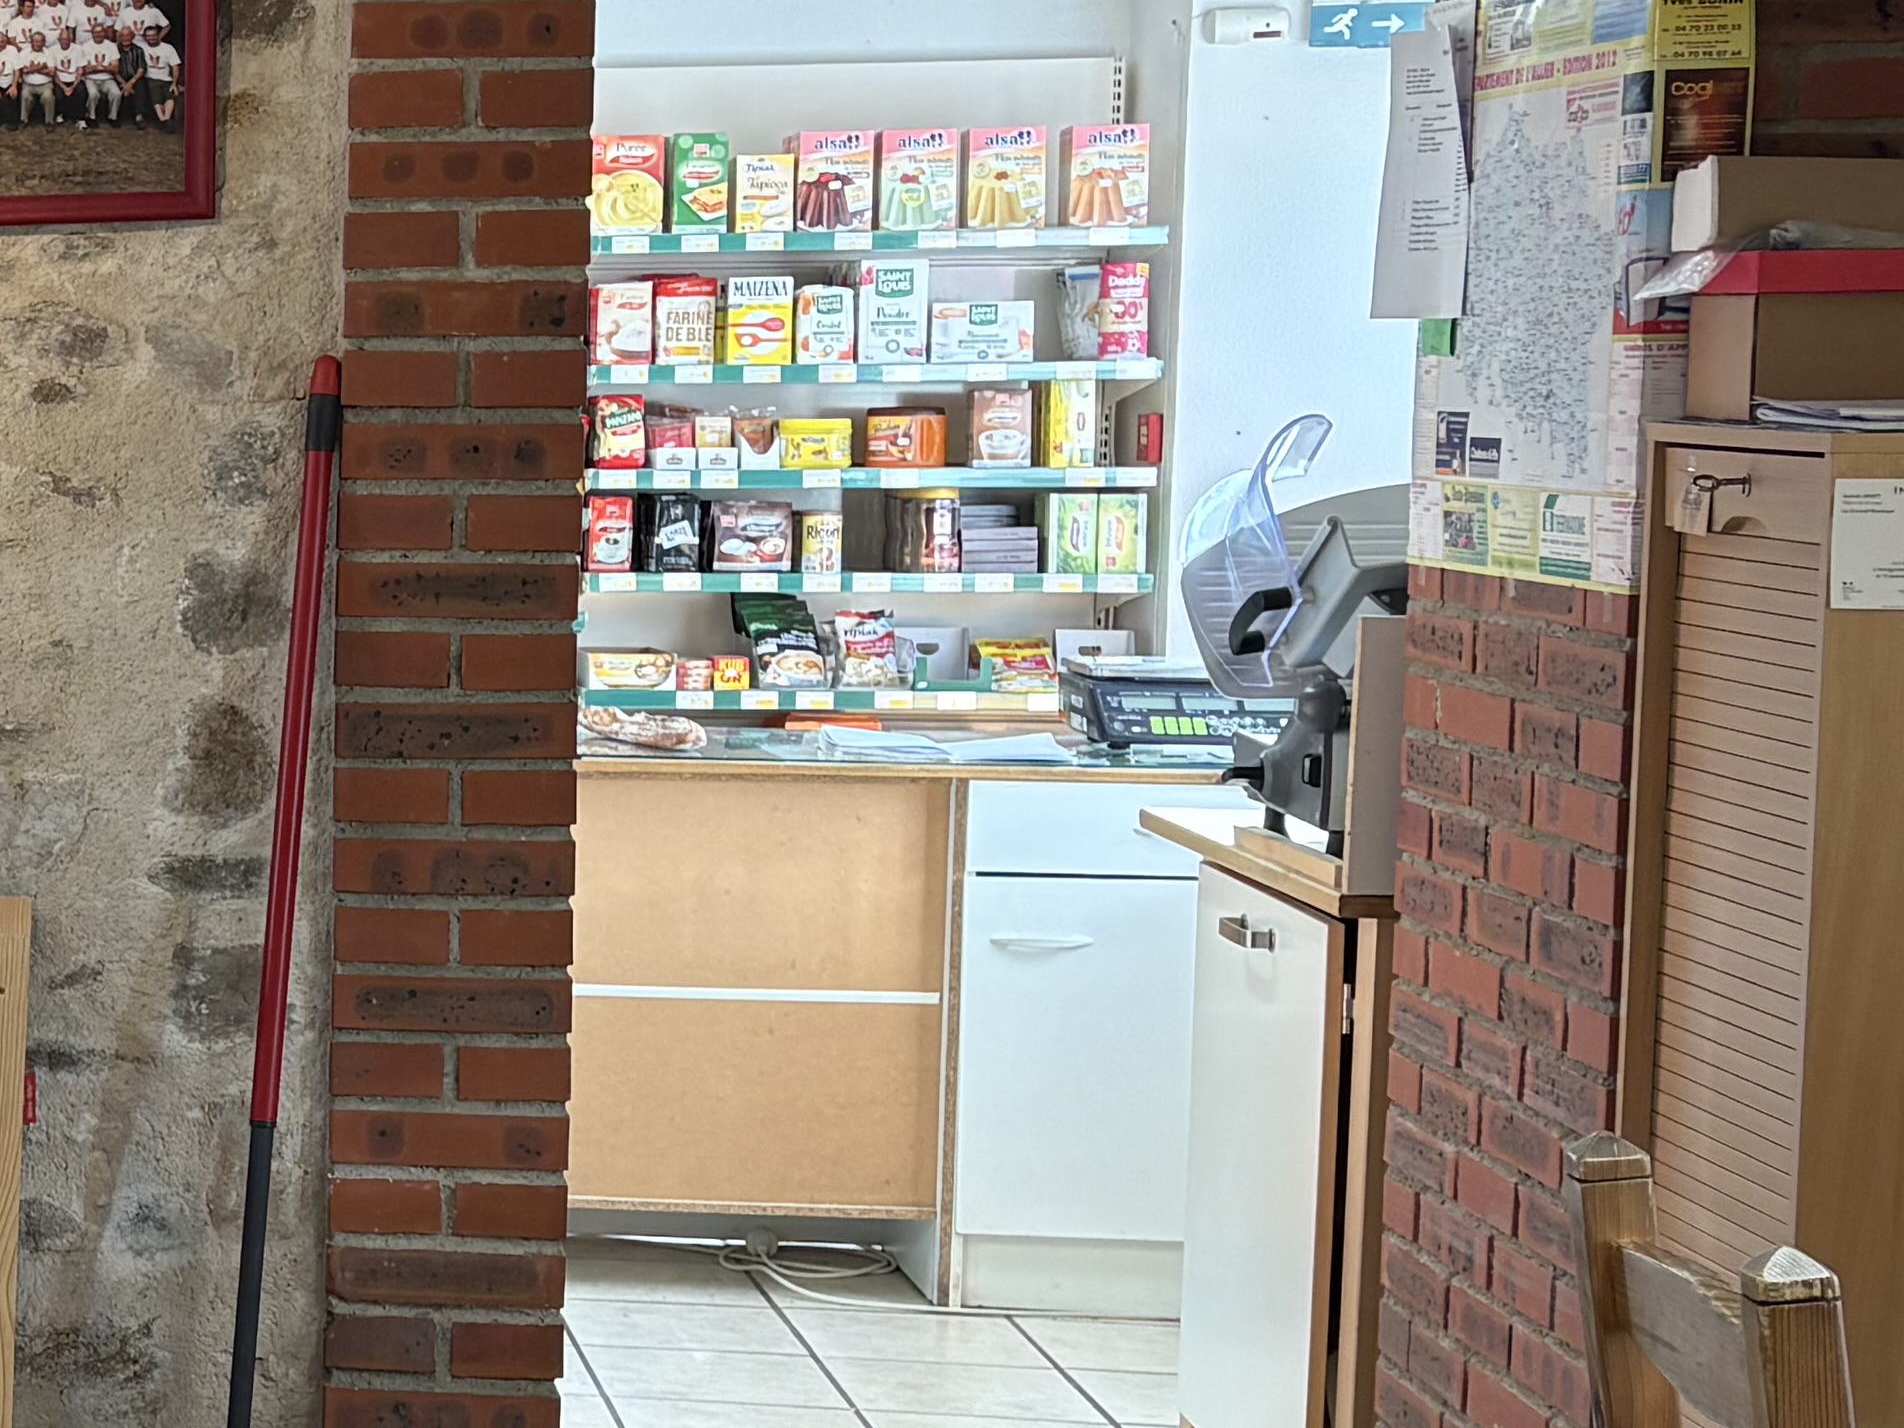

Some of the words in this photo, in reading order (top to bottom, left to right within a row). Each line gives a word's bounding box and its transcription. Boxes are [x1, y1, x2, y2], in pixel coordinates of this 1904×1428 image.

[1595, 50, 1618, 69] 2012
[814, 138, 847, 151] alsa
[898, 134, 930, 149] alsa
[985, 132, 1018, 147] alsa
[1088, 130, 1122, 145] alsa
[878, 271, 911, 283] SAINT
[878, 281, 910, 294] LOUIS
[666, 312, 713, 326] FARINE
[665, 327, 687, 342] DE
